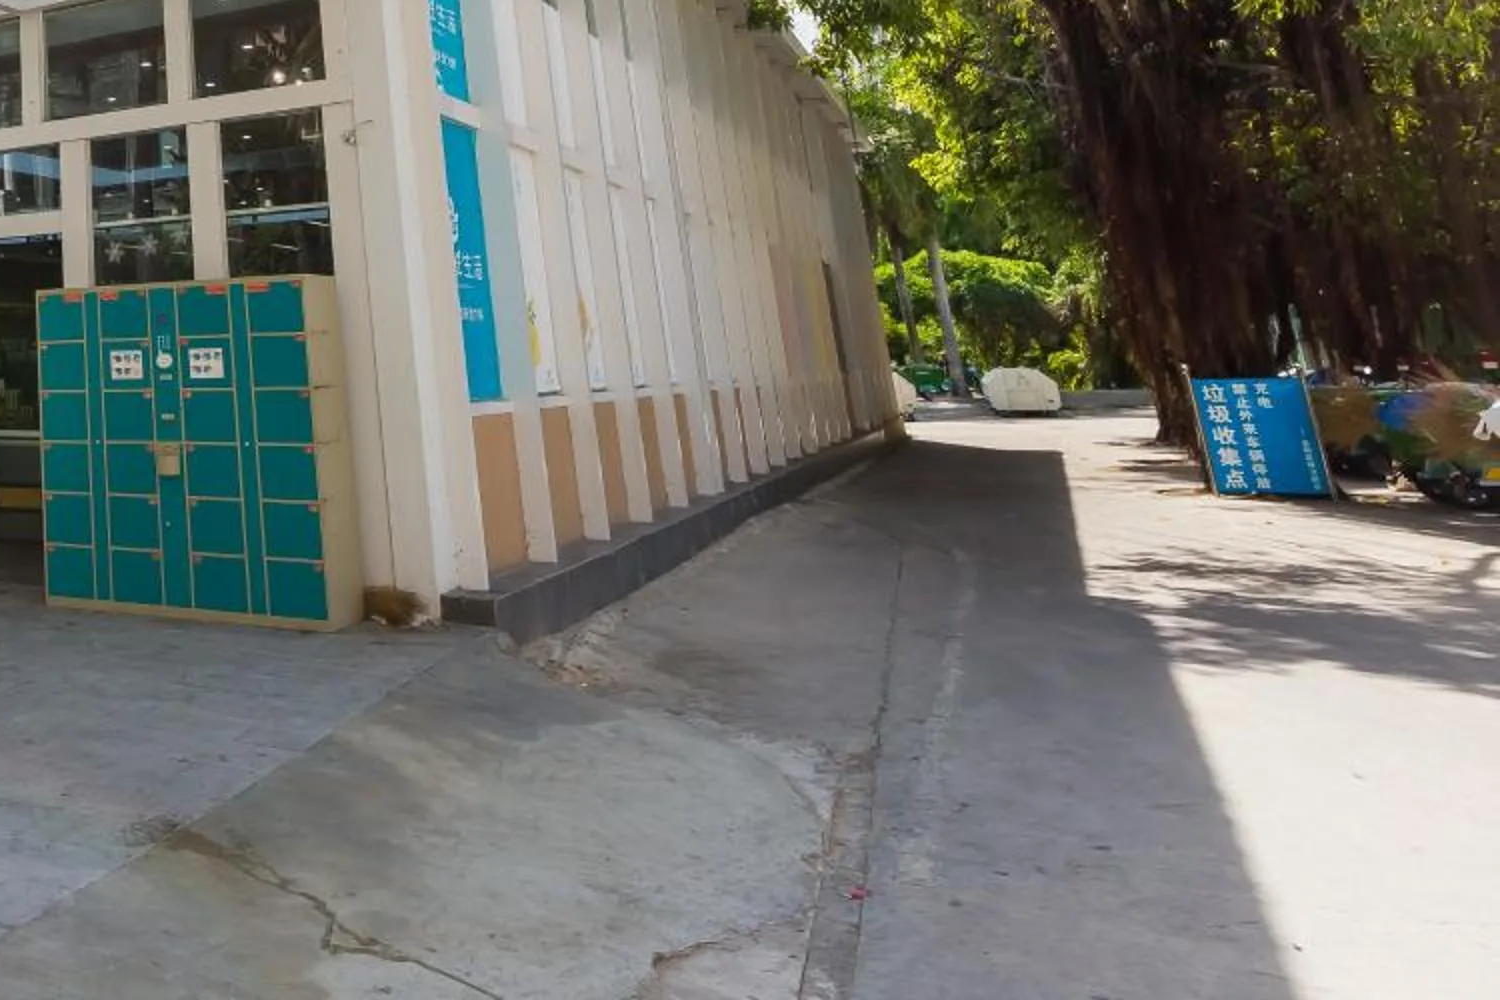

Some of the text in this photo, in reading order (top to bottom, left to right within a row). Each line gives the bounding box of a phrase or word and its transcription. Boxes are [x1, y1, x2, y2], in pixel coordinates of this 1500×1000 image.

[1202, 383, 1248, 489] 垃圾收集点
